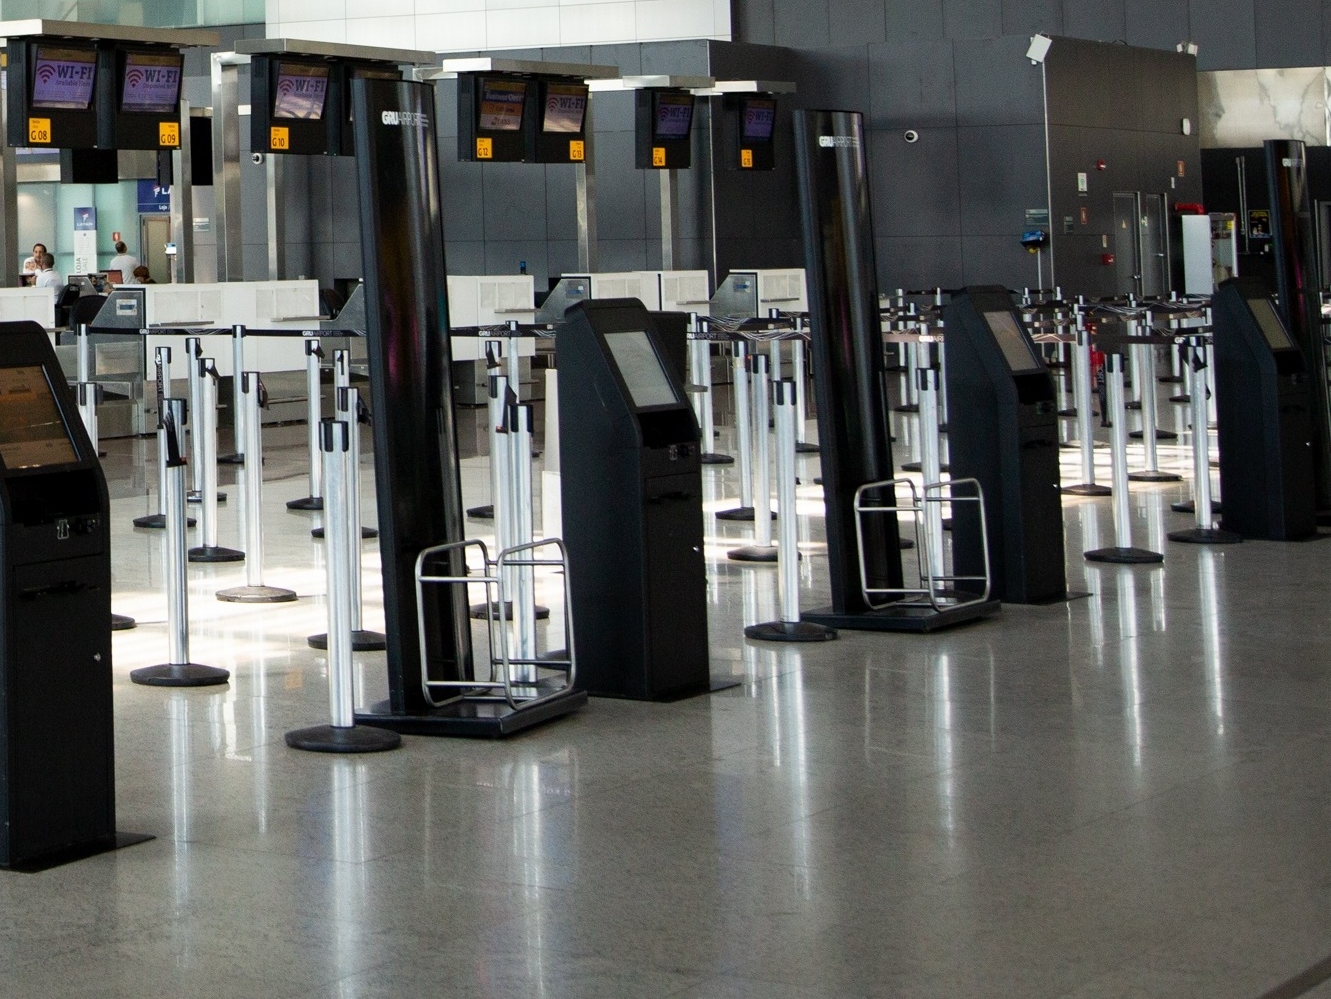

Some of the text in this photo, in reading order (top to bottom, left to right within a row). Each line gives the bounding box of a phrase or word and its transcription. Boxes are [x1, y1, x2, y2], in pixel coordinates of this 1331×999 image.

[57, 64, 93, 80] WI-FI
[144, 69, 178, 83] WI-FI
[295, 79, 325, 92] WI-FI
[559, 97, 584, 110] WI-FI
[30, 130, 48, 141] G 08
[160, 133, 176, 144] G 09
[272, 137, 285, 147] G 10
[478, 147, 488, 157] G 12
[577, 150, 582, 158] 13
